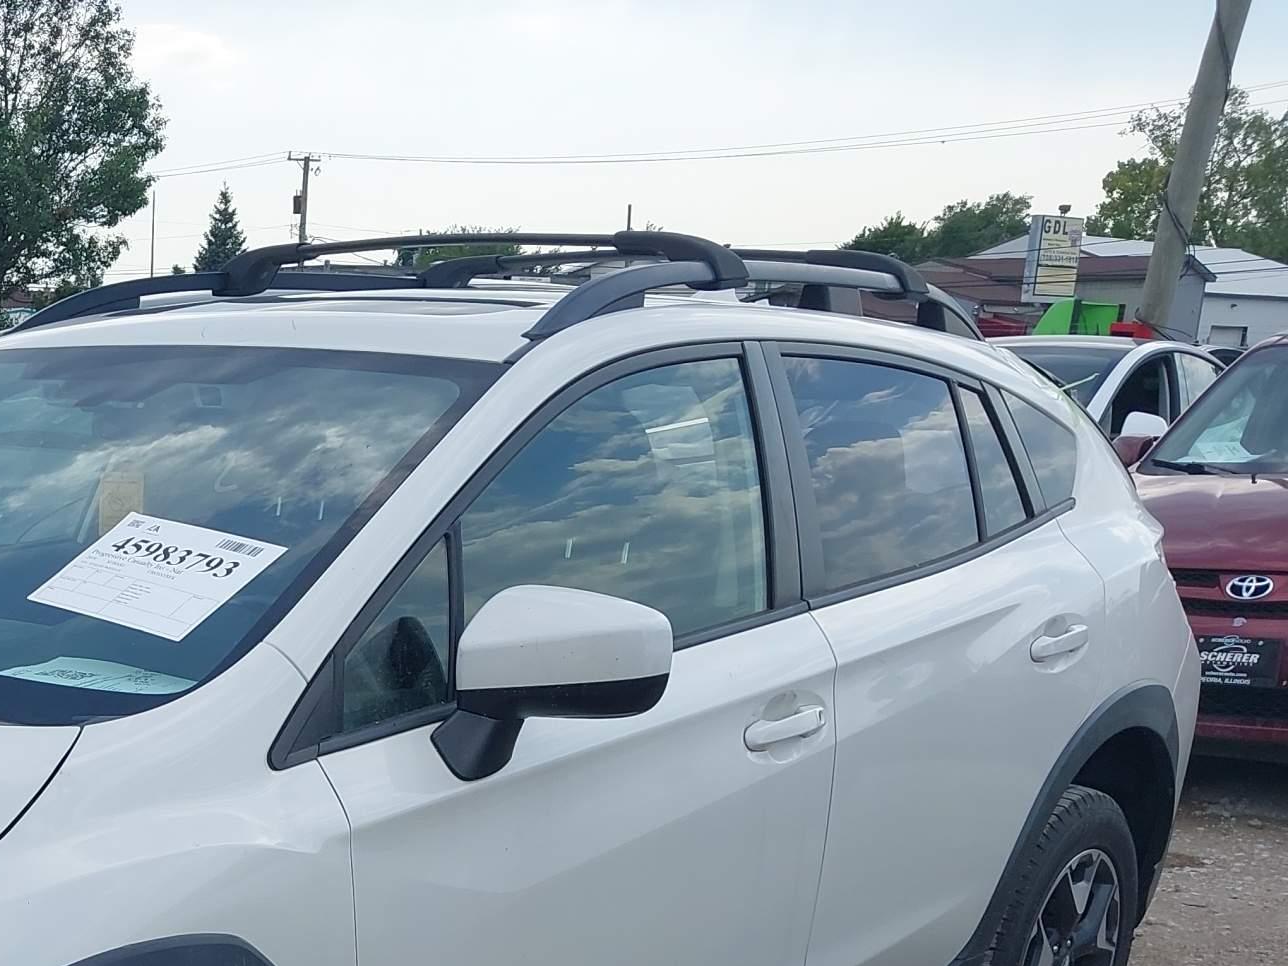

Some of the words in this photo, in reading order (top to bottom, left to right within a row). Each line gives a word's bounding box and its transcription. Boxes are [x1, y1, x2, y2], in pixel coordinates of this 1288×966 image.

[1044, 218, 1069, 235] GDL
[112, 536, 241, 578] 45983793
[1200, 651, 1260, 664] SCHERER
